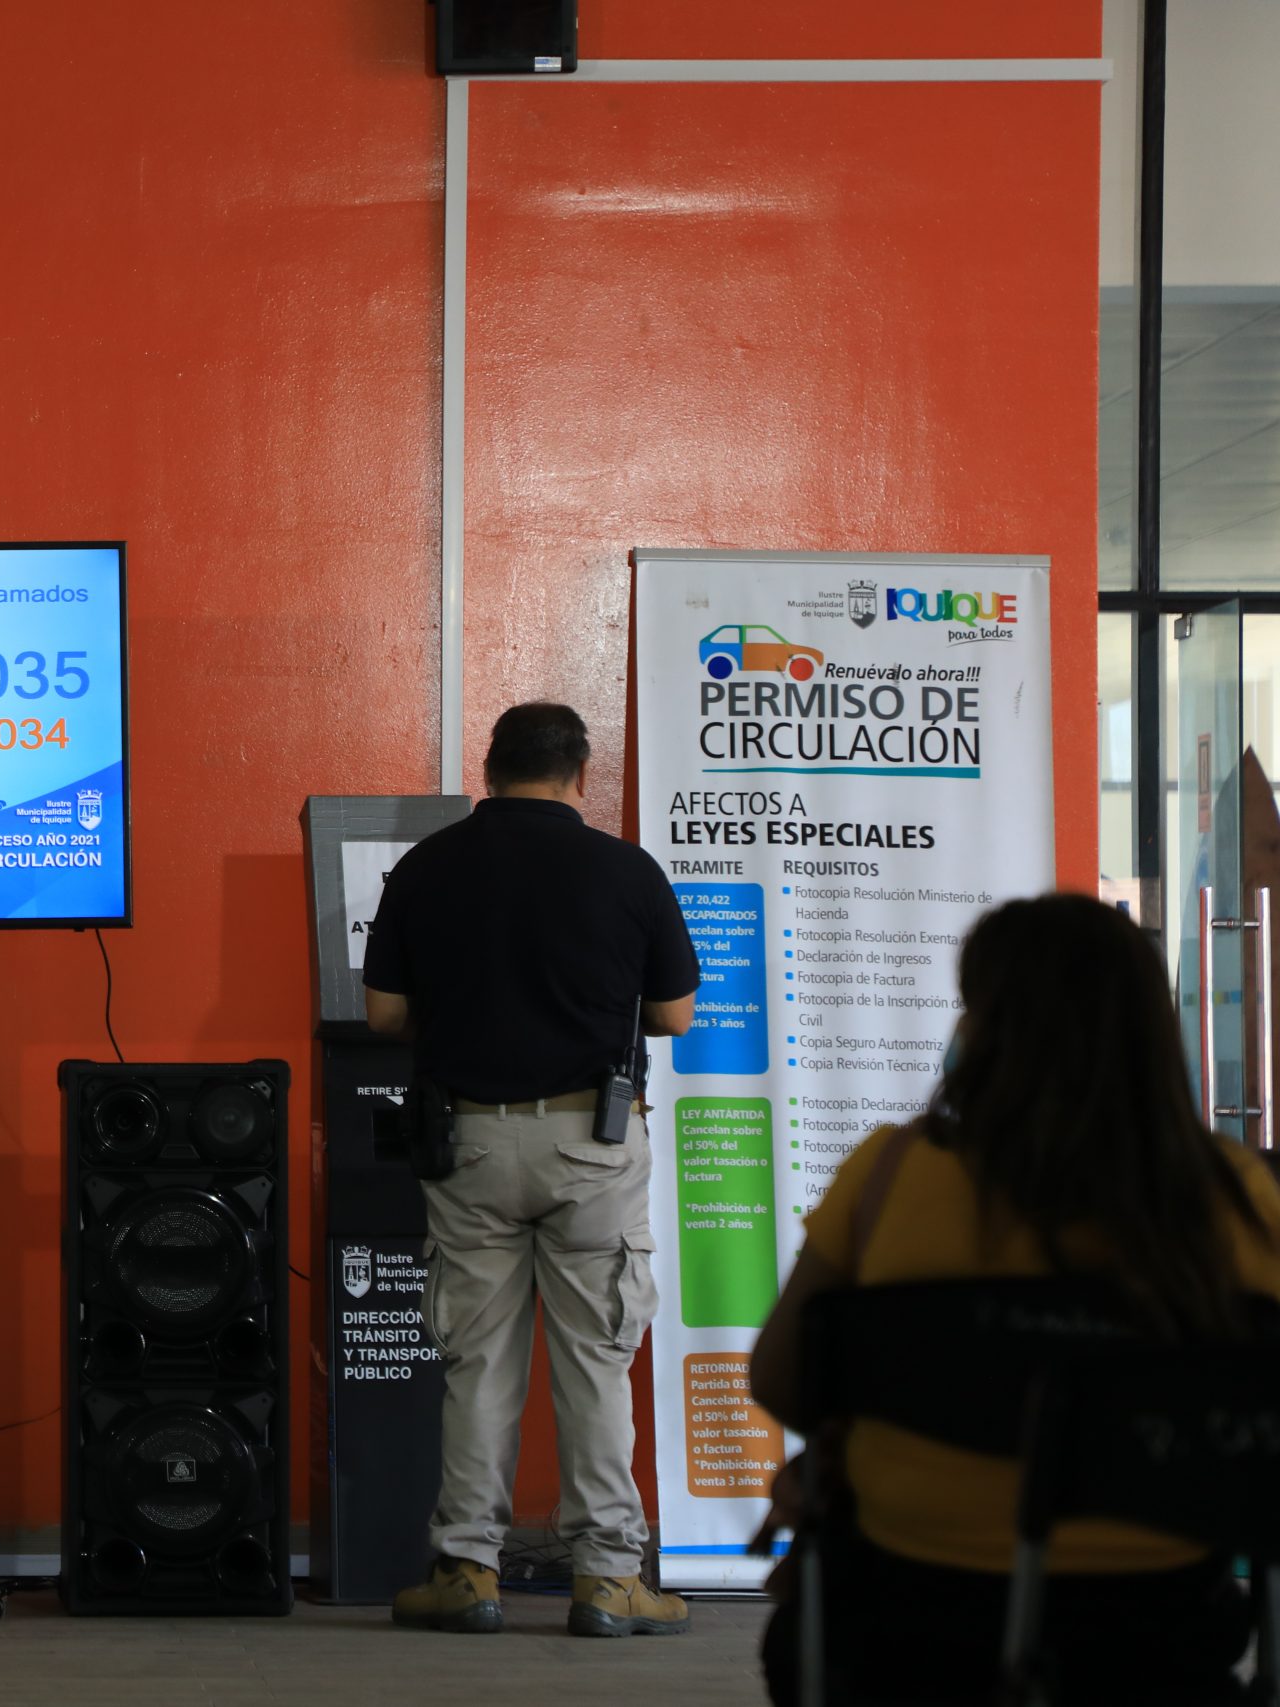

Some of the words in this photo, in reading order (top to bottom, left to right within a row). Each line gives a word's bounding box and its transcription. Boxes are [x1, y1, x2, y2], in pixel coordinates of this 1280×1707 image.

[788, 600, 844, 608] Municipalidad
[887, 588, 1017, 627] IQUIQUE
[814, 610, 844, 618] Iquique
[949, 629, 977, 642] para
[981, 626, 1013, 639] todos
[825, 663, 912, 681] Renuévalo
[917, 664, 980, 682] ahora!!!
[701, 681, 904, 720] PERMISO
[922, 686, 979, 722] DE
[700, 720, 980, 765] CIRCULACIÓN
[669, 792, 782, 816] AFECTOS
[789, 794, 806, 817] A
[36, 833, 66, 845] AÑO
[71, 835, 100, 845] 2021
[671, 821, 756, 845] LEYES
[767, 823, 935, 849] ESPECIALES
[671, 861, 743, 875] TRAMITE
[784, 860, 879, 877] REQUISITOS
[697, 895, 730, 905] 20,422
[795, 886, 850, 900] Fotocopia
[854, 887, 914, 900] Resolución
[918, 889, 975, 903] Ministerio
[978, 892, 992, 903] de
[682, 910, 757, 920] ISCAPACITADOS
[796, 908, 848, 920] Hacienda
[689, 925, 723, 935] ncelan
[726, 926, 755, 935] sobre
[797, 929, 851, 943] Fotocopia
[856, 930, 916, 943] Resolución
[921, 932, 958, 945] Exenta
[693, 942, 711, 950] 5%
[714, 942, 730, 950] del
[707, 957, 750, 966] tasación
[797, 950, 862, 962] Declaración
[866, 952, 880, 963] de
[884, 953, 932, 967] Ingresos
[798, 971, 853, 986] Fotocopia
[857, 972, 870, 984] de
[874, 973, 915, 986] Factura
[799, 992, 853, 1007] Fotocopia
[859, 993, 870, 1006] de
[875, 994, 884, 1006] la
[888, 996, 948, 1010] Inscripción
[694, 1002, 743, 1012] ohibición
[746, 1003, 759, 1012] de
[691, 1019, 708, 1027] nta
[720, 1019, 745, 1028] años
[799, 1014, 822, 1026] Civil
[800, 1036, 832, 1050] Copia
[836, 1037, 875, 1051] Seguro
[878, 1038, 943, 1051] Automotriz
[801, 1057, 833, 1072] Copia
[837, 1058, 883, 1070] Revisión
[887, 1060, 929, 1072] Técnica
[933, 1064, 940, 1075] y
[358, 1087, 392, 1095] RETIRE
[803, 1097, 858, 1112] Fotocopia
[862, 1098, 928, 1112] Declaración
[682, 1110, 700, 1119] LEY
[704, 1109, 765, 1120] ANTÁRTIDA
[683, 1125, 730, 1135] Cancelan
[733, 1126, 763, 1135] sobre
[803, 1118, 858, 1133] Fotocopia
[684, 1141, 692, 1150] el
[695, 1141, 718, 1150] 50%
[722, 1141, 737, 1150] del
[684, 1156, 711, 1166] valor
[714, 1157, 758, 1166] tasación
[684, 1171, 722, 1181] factura
[754, 1204, 767, 1213] de
[686, 1219, 716, 1228] venta
[719, 1219, 725, 1228] 2
[728, 1220, 753, 1229] años
[376, 1254, 413, 1264] Ilustre
[377, 1268, 428, 1279] Municipa
[378, 1282, 391, 1291] de
[395, 1281, 424, 1293] Iquiq
[343, 1327, 420, 1342] TRÁNSITO
[344, 1349, 353, 1360] Y
[358, 1348, 441, 1360] TRANSPOR
[345, 1364, 412, 1379] PÚBLICO
[691, 1364, 750, 1373] RETORNAD
[692, 1380, 730, 1390] Partida
[692, 1396, 740, 1406] Cancelan
[692, 1412, 702, 1421] el
[705, 1412, 728, 1421] 50%
[731, 1411, 748, 1421] del
[693, 1428, 720, 1438] valor
[724, 1427, 768, 1438] tasación
[694, 1446, 700, 1454] o
[704, 1444, 742, 1454] factura
[764, 1461, 777, 1470] de
[694, 1477, 725, 1486] venta
[729, 1477, 734, 1486] 3
[738, 1476, 764, 1486] años
